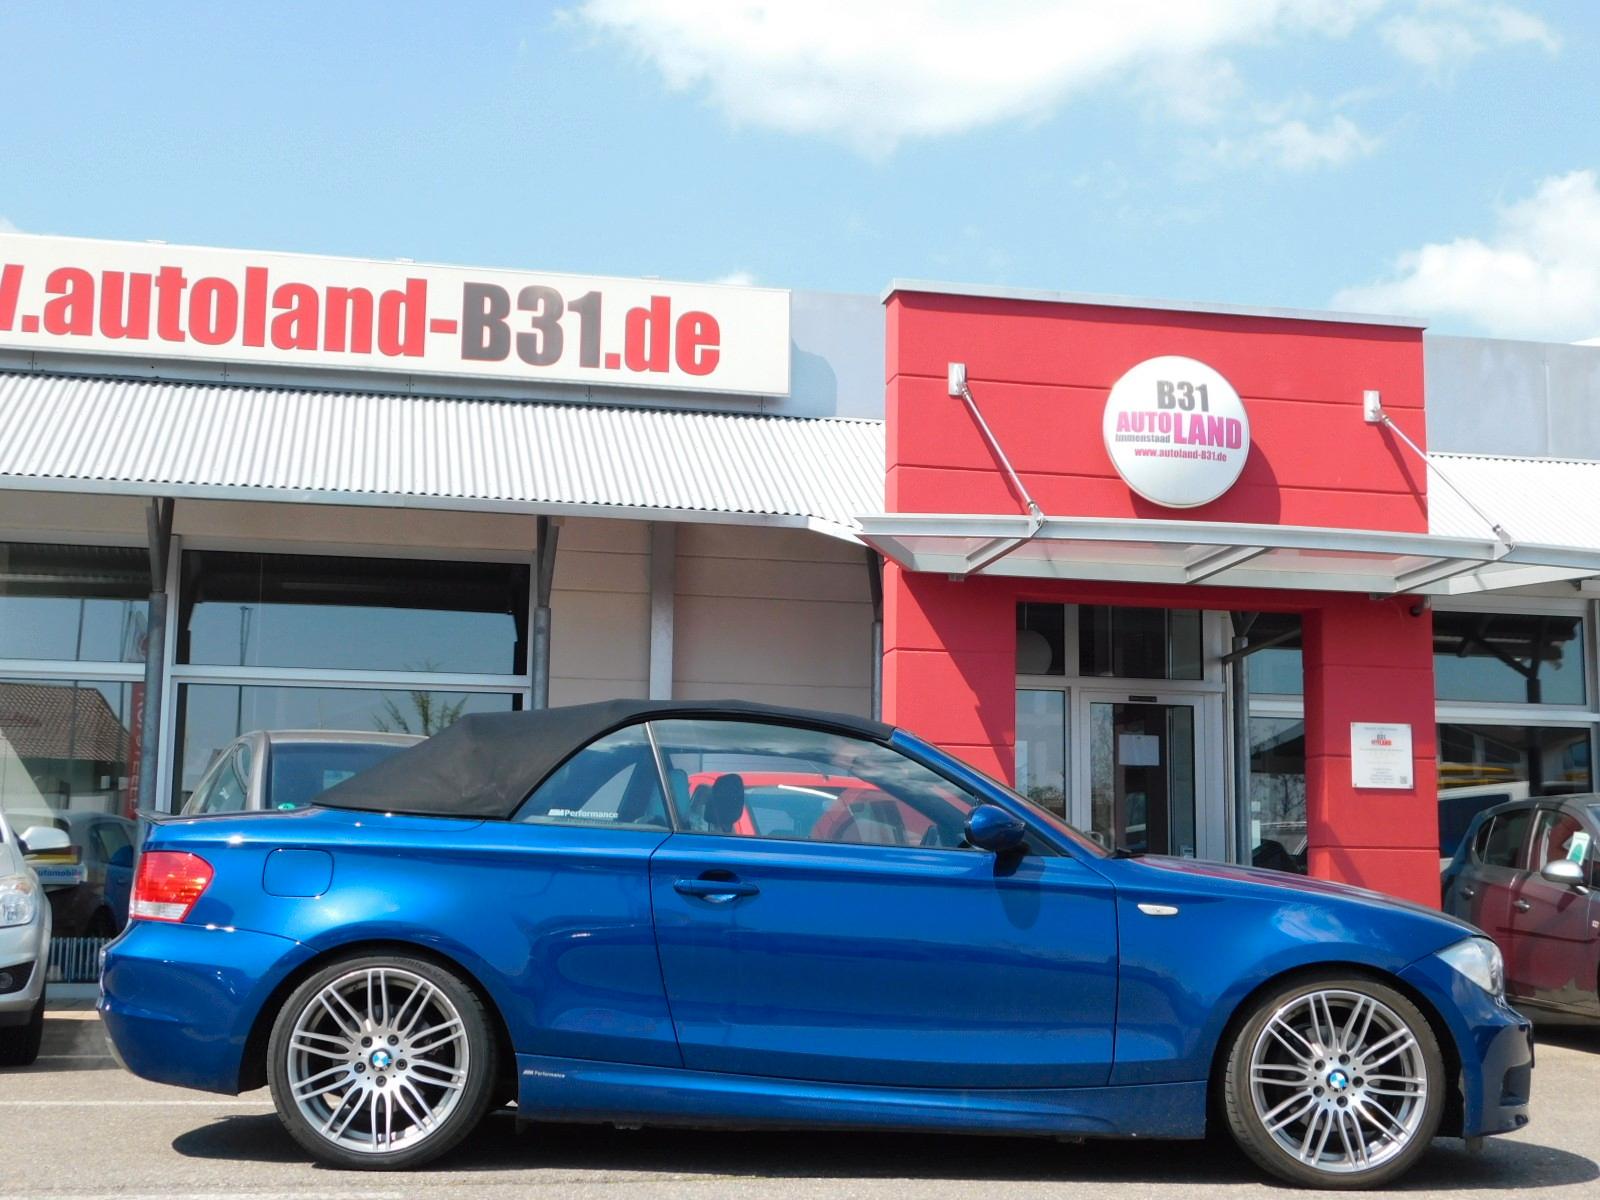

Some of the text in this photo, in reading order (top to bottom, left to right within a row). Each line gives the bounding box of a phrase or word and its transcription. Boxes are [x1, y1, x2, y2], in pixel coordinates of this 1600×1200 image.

[1157, 380, 1209, 412] B31
[1135, 448, 1227, 461] www.autoland-B31.de
[564, 809, 618, 818] Performance
